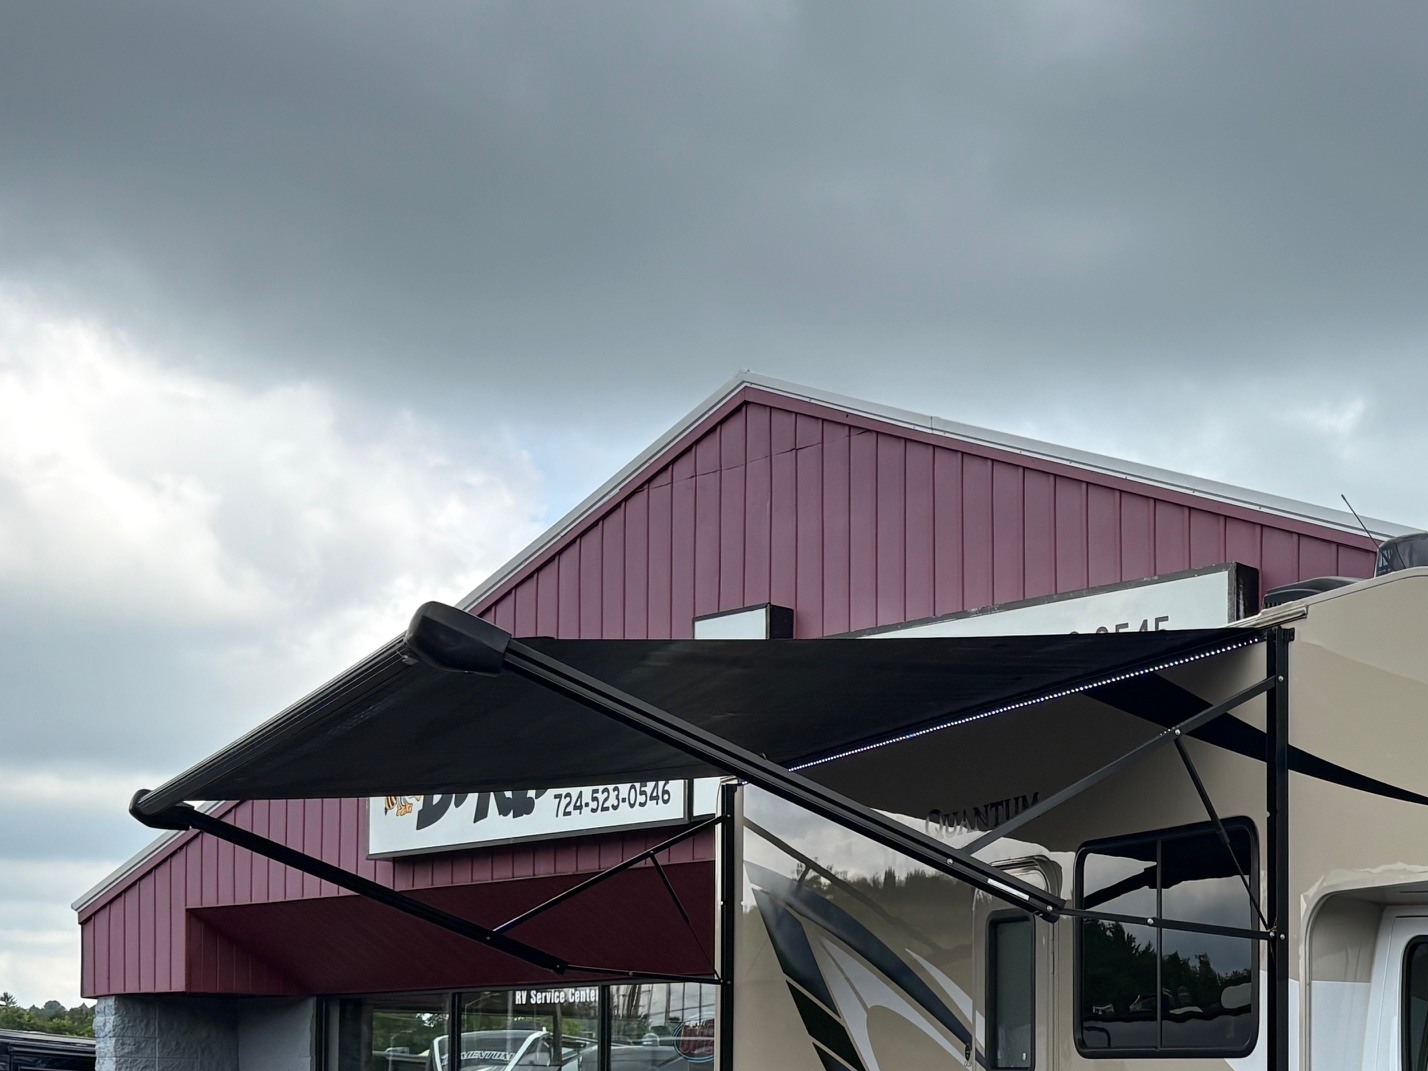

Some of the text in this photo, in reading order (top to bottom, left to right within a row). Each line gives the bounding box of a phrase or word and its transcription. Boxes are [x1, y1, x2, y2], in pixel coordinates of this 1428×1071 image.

[554, 781, 671, 818] 724-523-0546
[515, 990, 527, 1004] RV
[530, 988, 565, 1004] Service
